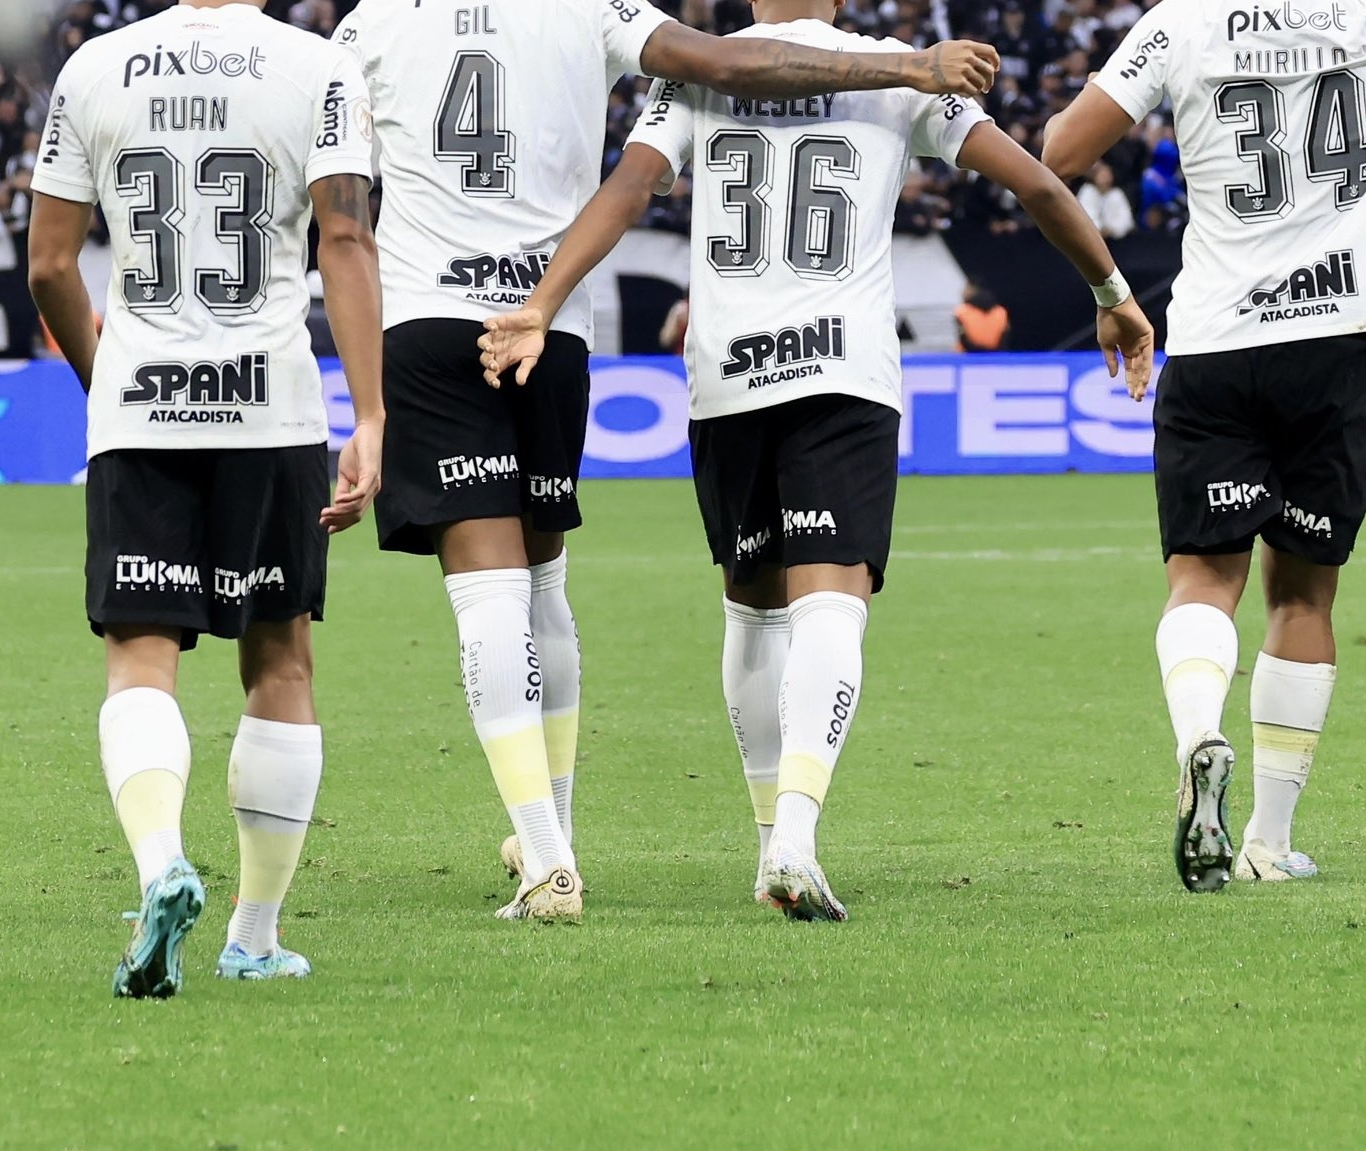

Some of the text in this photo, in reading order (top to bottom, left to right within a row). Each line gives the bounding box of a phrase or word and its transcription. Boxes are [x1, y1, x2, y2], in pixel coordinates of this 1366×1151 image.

[455, 5, 497, 36] GIL
[1227, 0, 1348, 41] pixbet
[123, 41, 266, 87] pixbet
[1128, 29, 1170, 70] bmg
[149, 96, 229, 132] RUAN
[316, 96, 345, 149] bmg
[939, 93, 964, 121] mg
[433, 50, 516, 199] 4
[706, 129, 861, 282] 36
[113, 147, 276, 316] 33
[466, 292, 530, 305] ATACADIS
[1260, 303, 1340, 324] ATACADISTA
[747, 363, 823, 391] ATACADISTA
[148, 410, 243, 424] ATACADISTA
[438, 455, 465, 466] GRUPO
[1207, 481, 1234, 490] GRUPO
[116, 555, 148, 563] GRUPO
[215, 566, 285, 598] LUMA
[469, 641, 483, 708] Cartão de
[827, 680, 856, 748] TODOS
